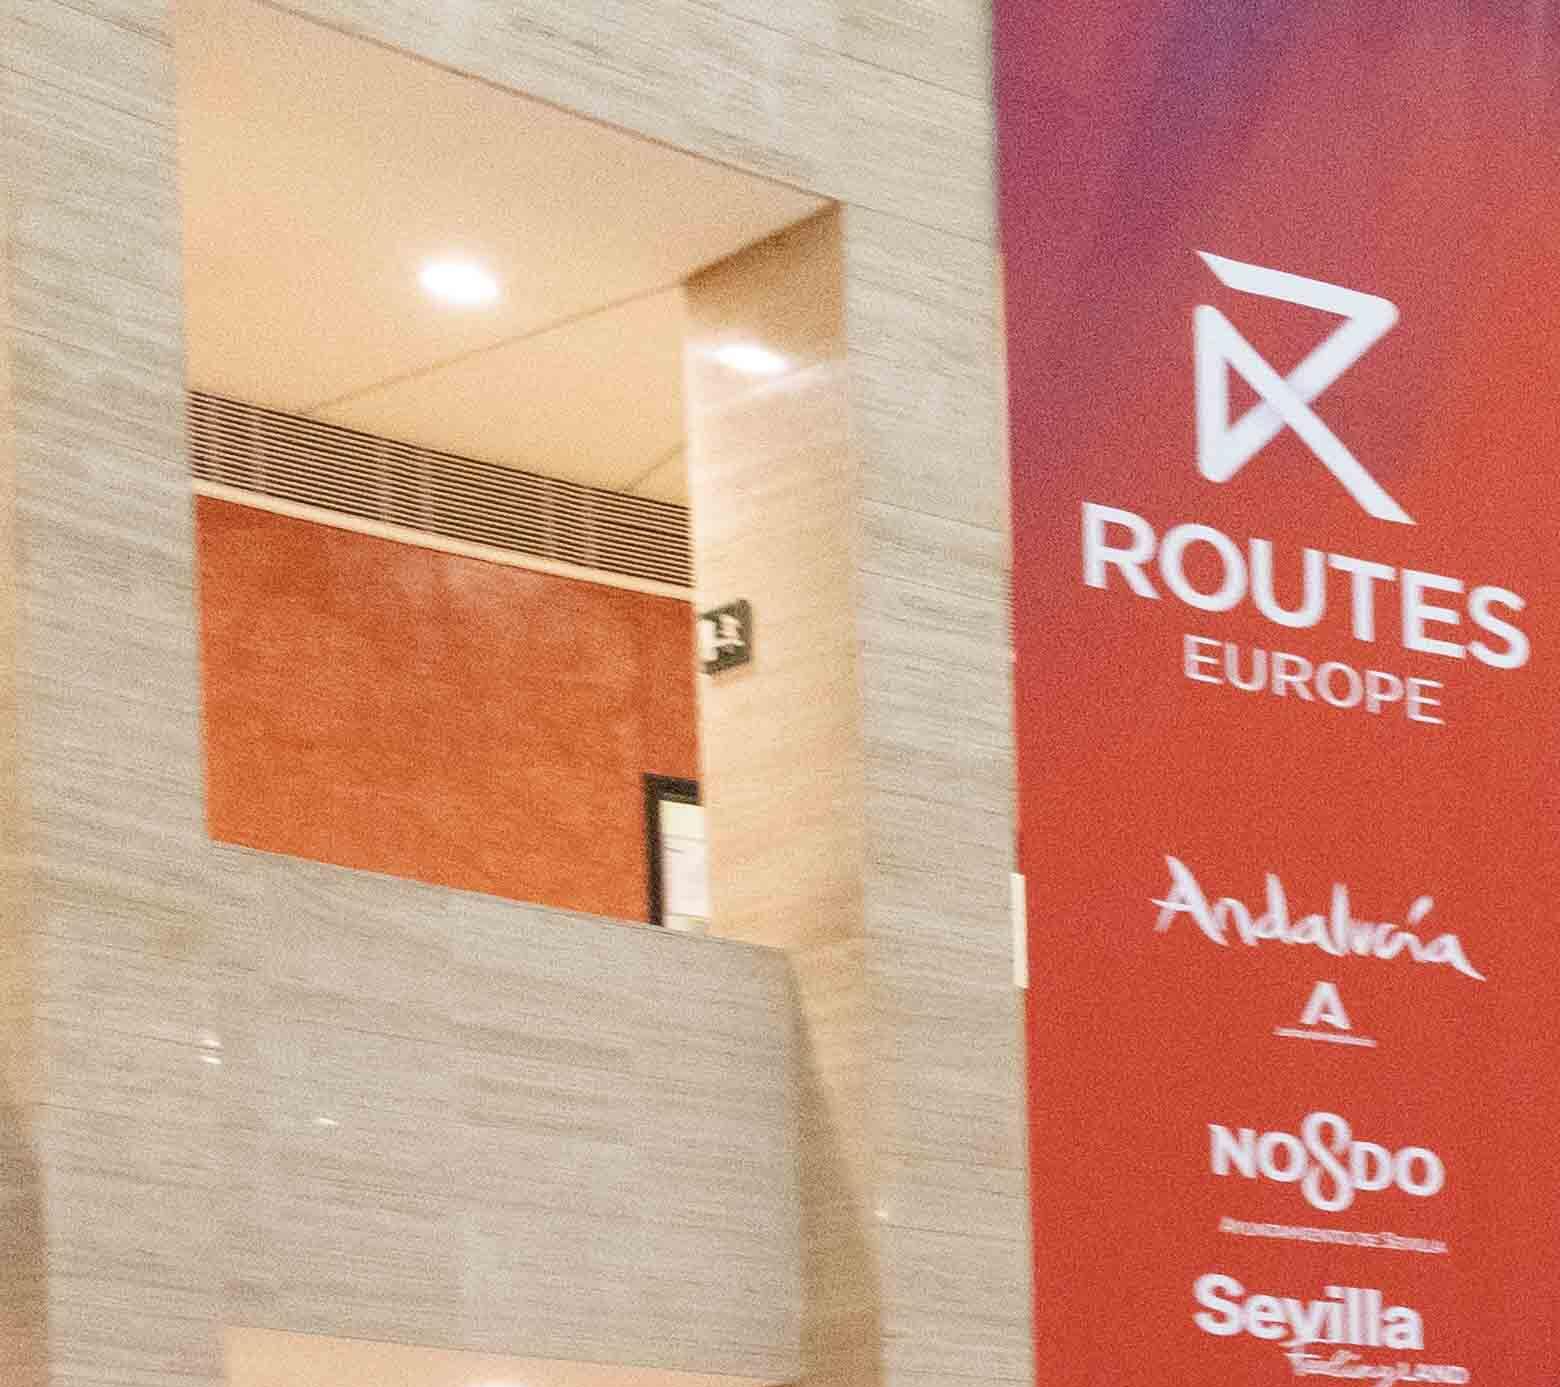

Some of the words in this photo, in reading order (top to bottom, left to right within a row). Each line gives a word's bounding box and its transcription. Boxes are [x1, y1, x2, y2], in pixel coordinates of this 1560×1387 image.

[1081, 501, 1530, 670] ROUTES
[1183, 634, 1446, 726] EUROPE
[1151, 854, 1487, 982] Andalucía
[1192, 1272, 1425, 1350] Sevilla
